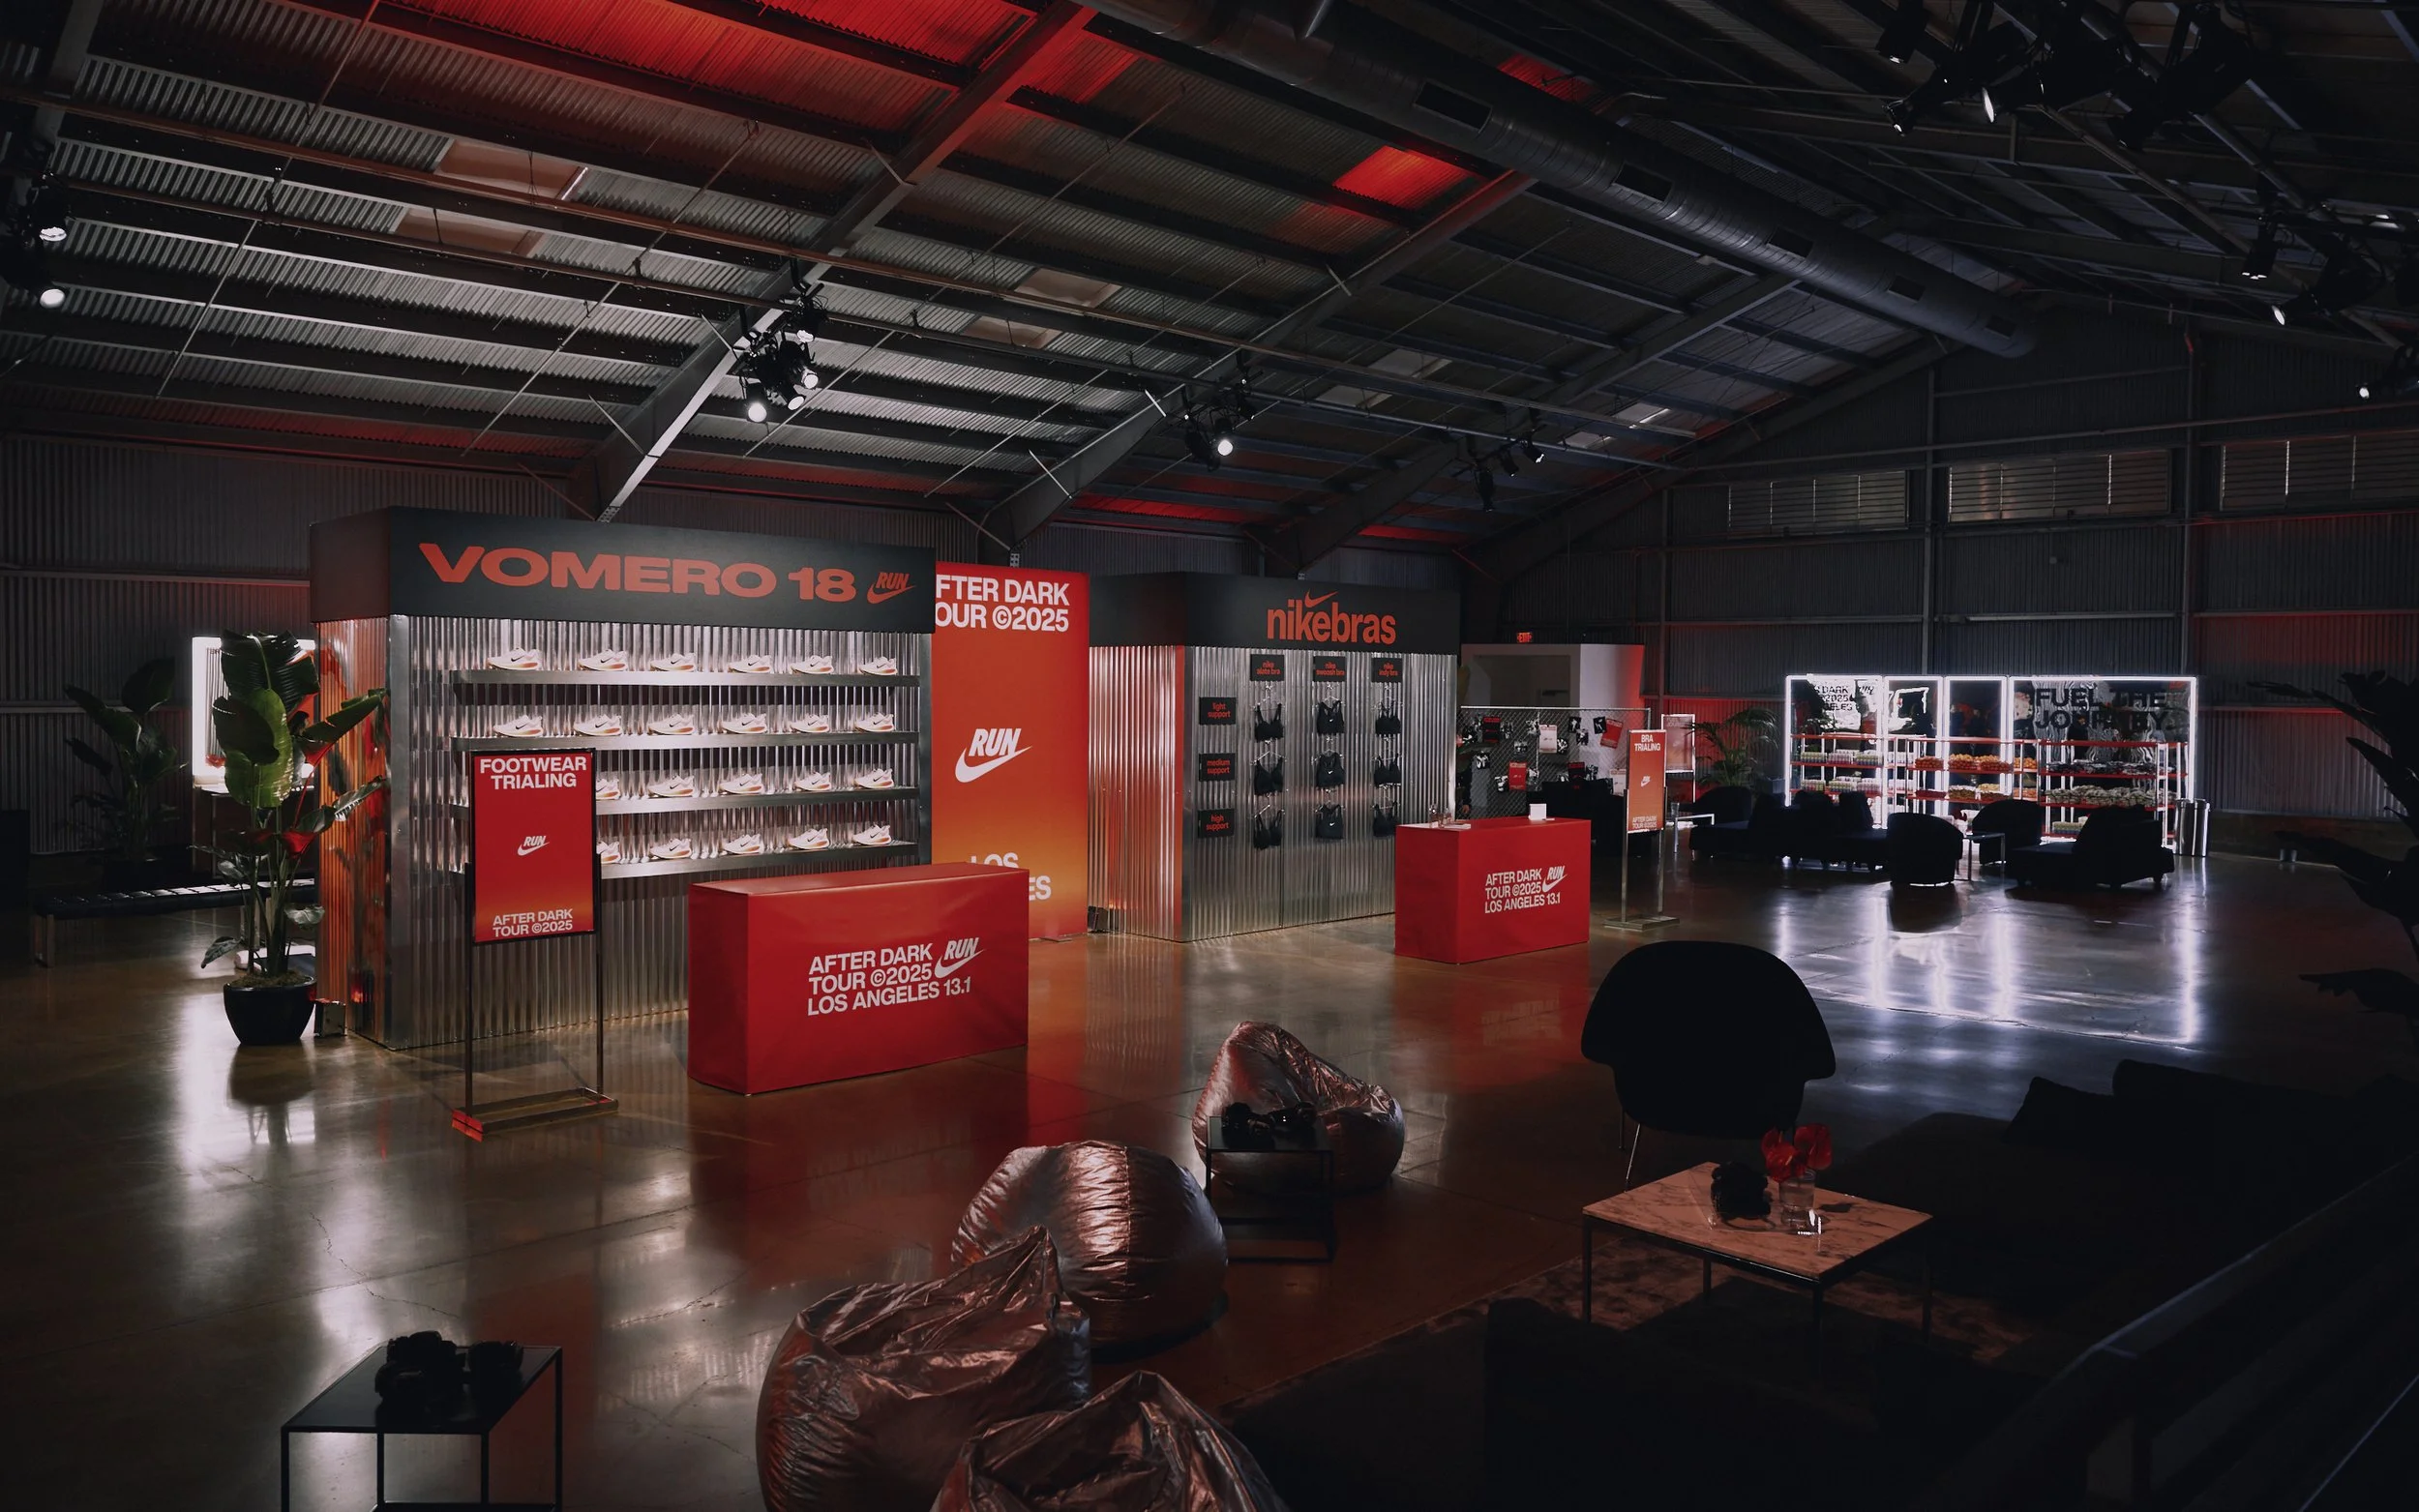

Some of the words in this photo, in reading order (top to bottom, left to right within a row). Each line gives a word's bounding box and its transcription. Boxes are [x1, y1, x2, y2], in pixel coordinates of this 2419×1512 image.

[419, 542, 777, 599] VOMERO
[789, 567, 856, 603] 18
[876, 572, 911, 590] RUN
[936, 574, 999, 602] FTER
[1004, 578, 1070, 607] DARK
[935, 602, 987, 629] OUR
[993, 606, 1069, 633] ©2025
[1267, 598, 1396, 644] nikebras
[1212, 702, 1226, 712] light
[2036, 688, 2102, 707] FUEL
[1208, 711, 1231, 720] support
[969, 728, 1021, 757] RUN
[1634, 743, 1660, 752] TRIALING
[1641, 734, 1654, 743] BRA
[480, 756, 587, 775] FOOTWEAR
[1207, 766, 1231, 776] support
[491, 773, 577, 790] TRIALING
[1206, 822, 1230, 832] support
[1210, 815, 1224, 824] high
[523, 835, 547, 847] RUN
[1485, 871, 1516, 886] AFTER
[1516, 868, 1542, 882] DARK
[1546, 865, 1566, 880] RUN
[1484, 884, 1510, 900] TOUR
[1511, 881, 1541, 897] ©2025
[1484, 900, 1503, 913] LOS
[1504, 894, 1545, 911] ANGELES
[1545, 892, 1561, 905] 13.1
[493, 911, 535, 927] AFTER
[537, 908, 573, 922] DARK
[493, 925, 529, 937] TOUR
[531, 919, 573, 934] ©2025
[943, 936, 979, 961] RUN
[809, 950, 877, 976] AFTER
[880, 942, 934, 966] DARK
[808, 971, 867, 995] TOUR
[870, 963, 933, 988] ©2025
[807, 993, 849, 1017] LOS
[852, 981, 941, 1011] ANGELES
[943, 975, 971, 996] 13.1
